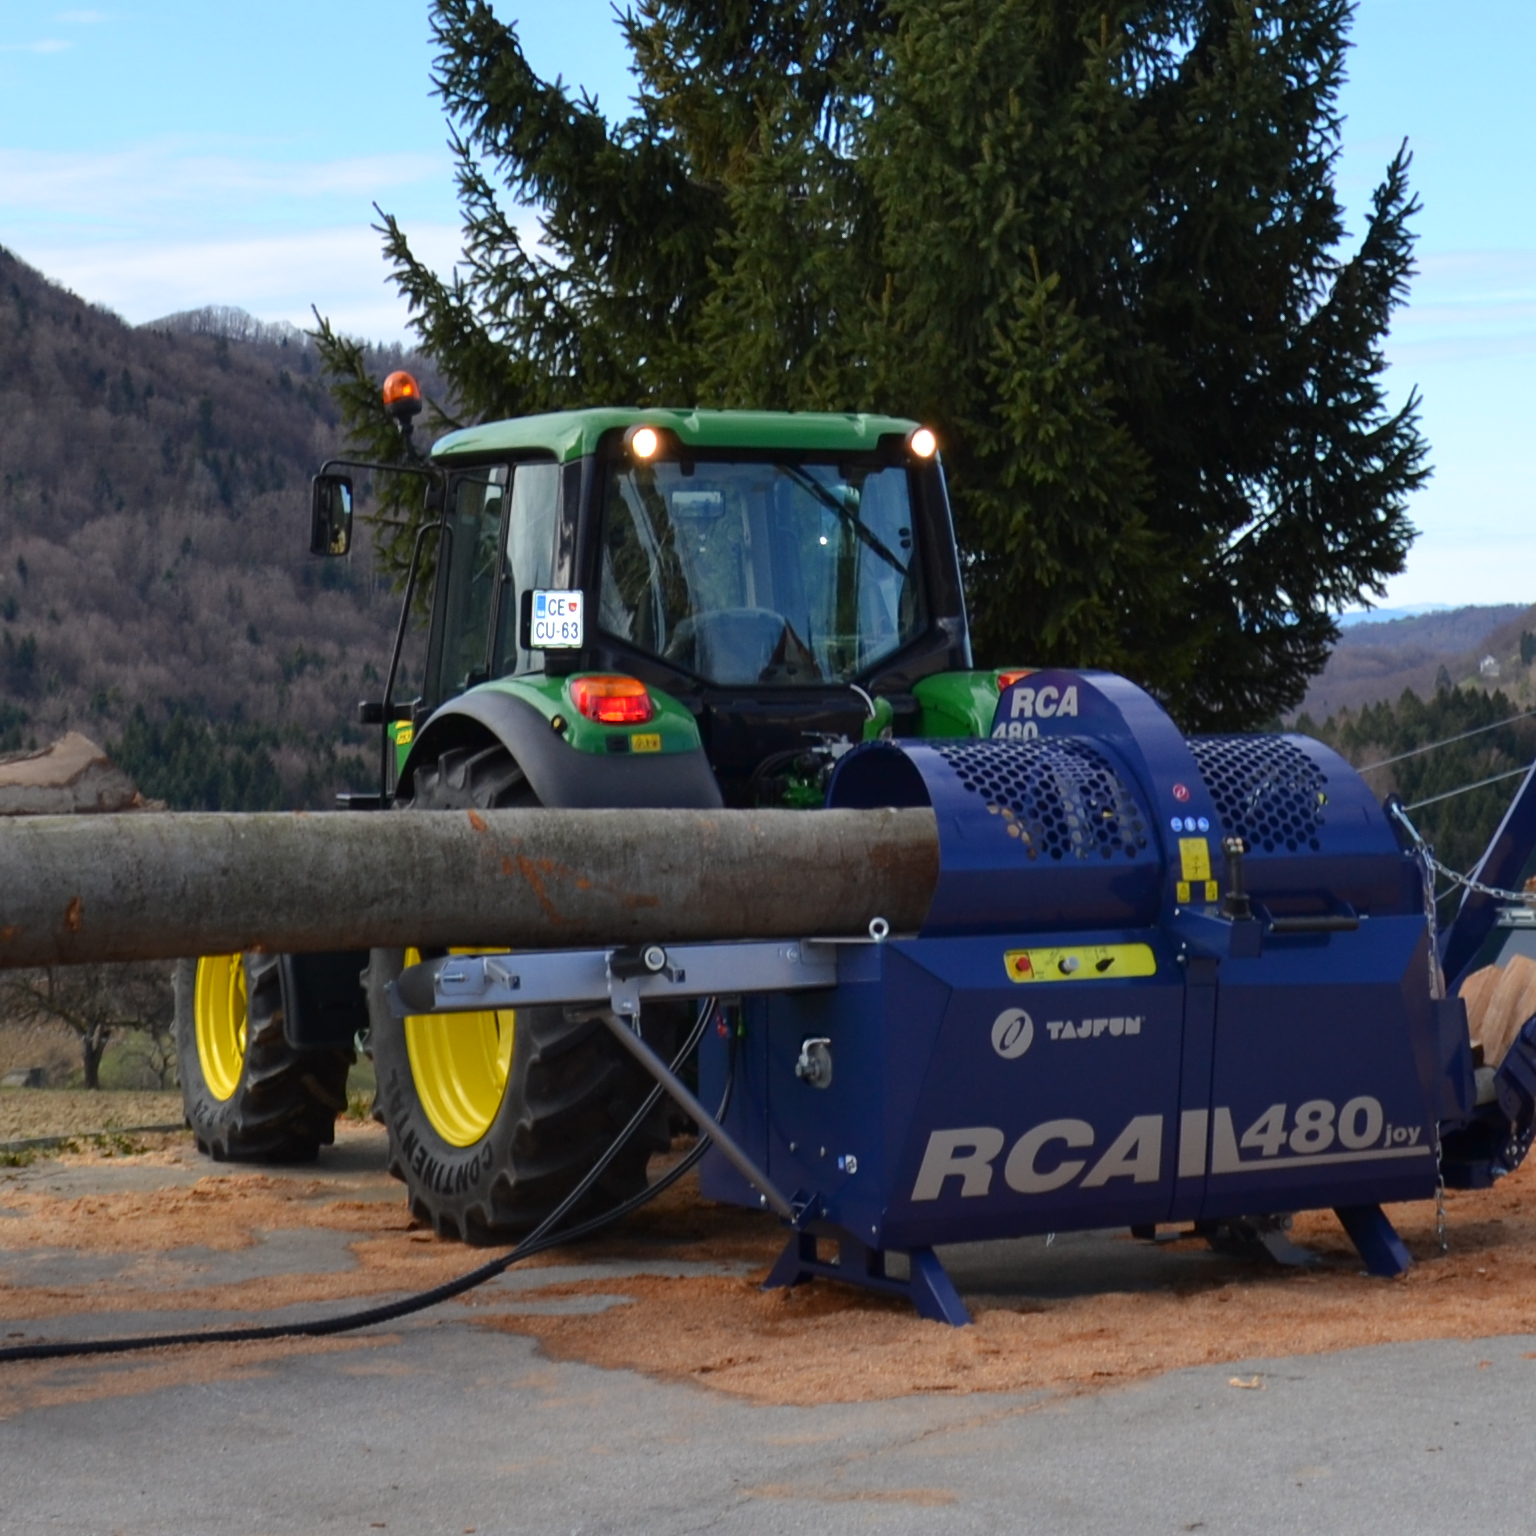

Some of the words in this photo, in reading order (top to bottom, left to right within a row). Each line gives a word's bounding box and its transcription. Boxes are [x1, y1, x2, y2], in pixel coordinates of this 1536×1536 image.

[548, 599, 565, 616] CE
[536, 622, 578, 639] CU-63
[1011, 686, 1078, 718] RCA
[992, 721, 1038, 740] 480
[1047, 1016, 1141, 1040] TAJFUN
[386, 1068, 492, 1195] CONTINENTAL
[1240, 1096, 1383, 1156] 480
